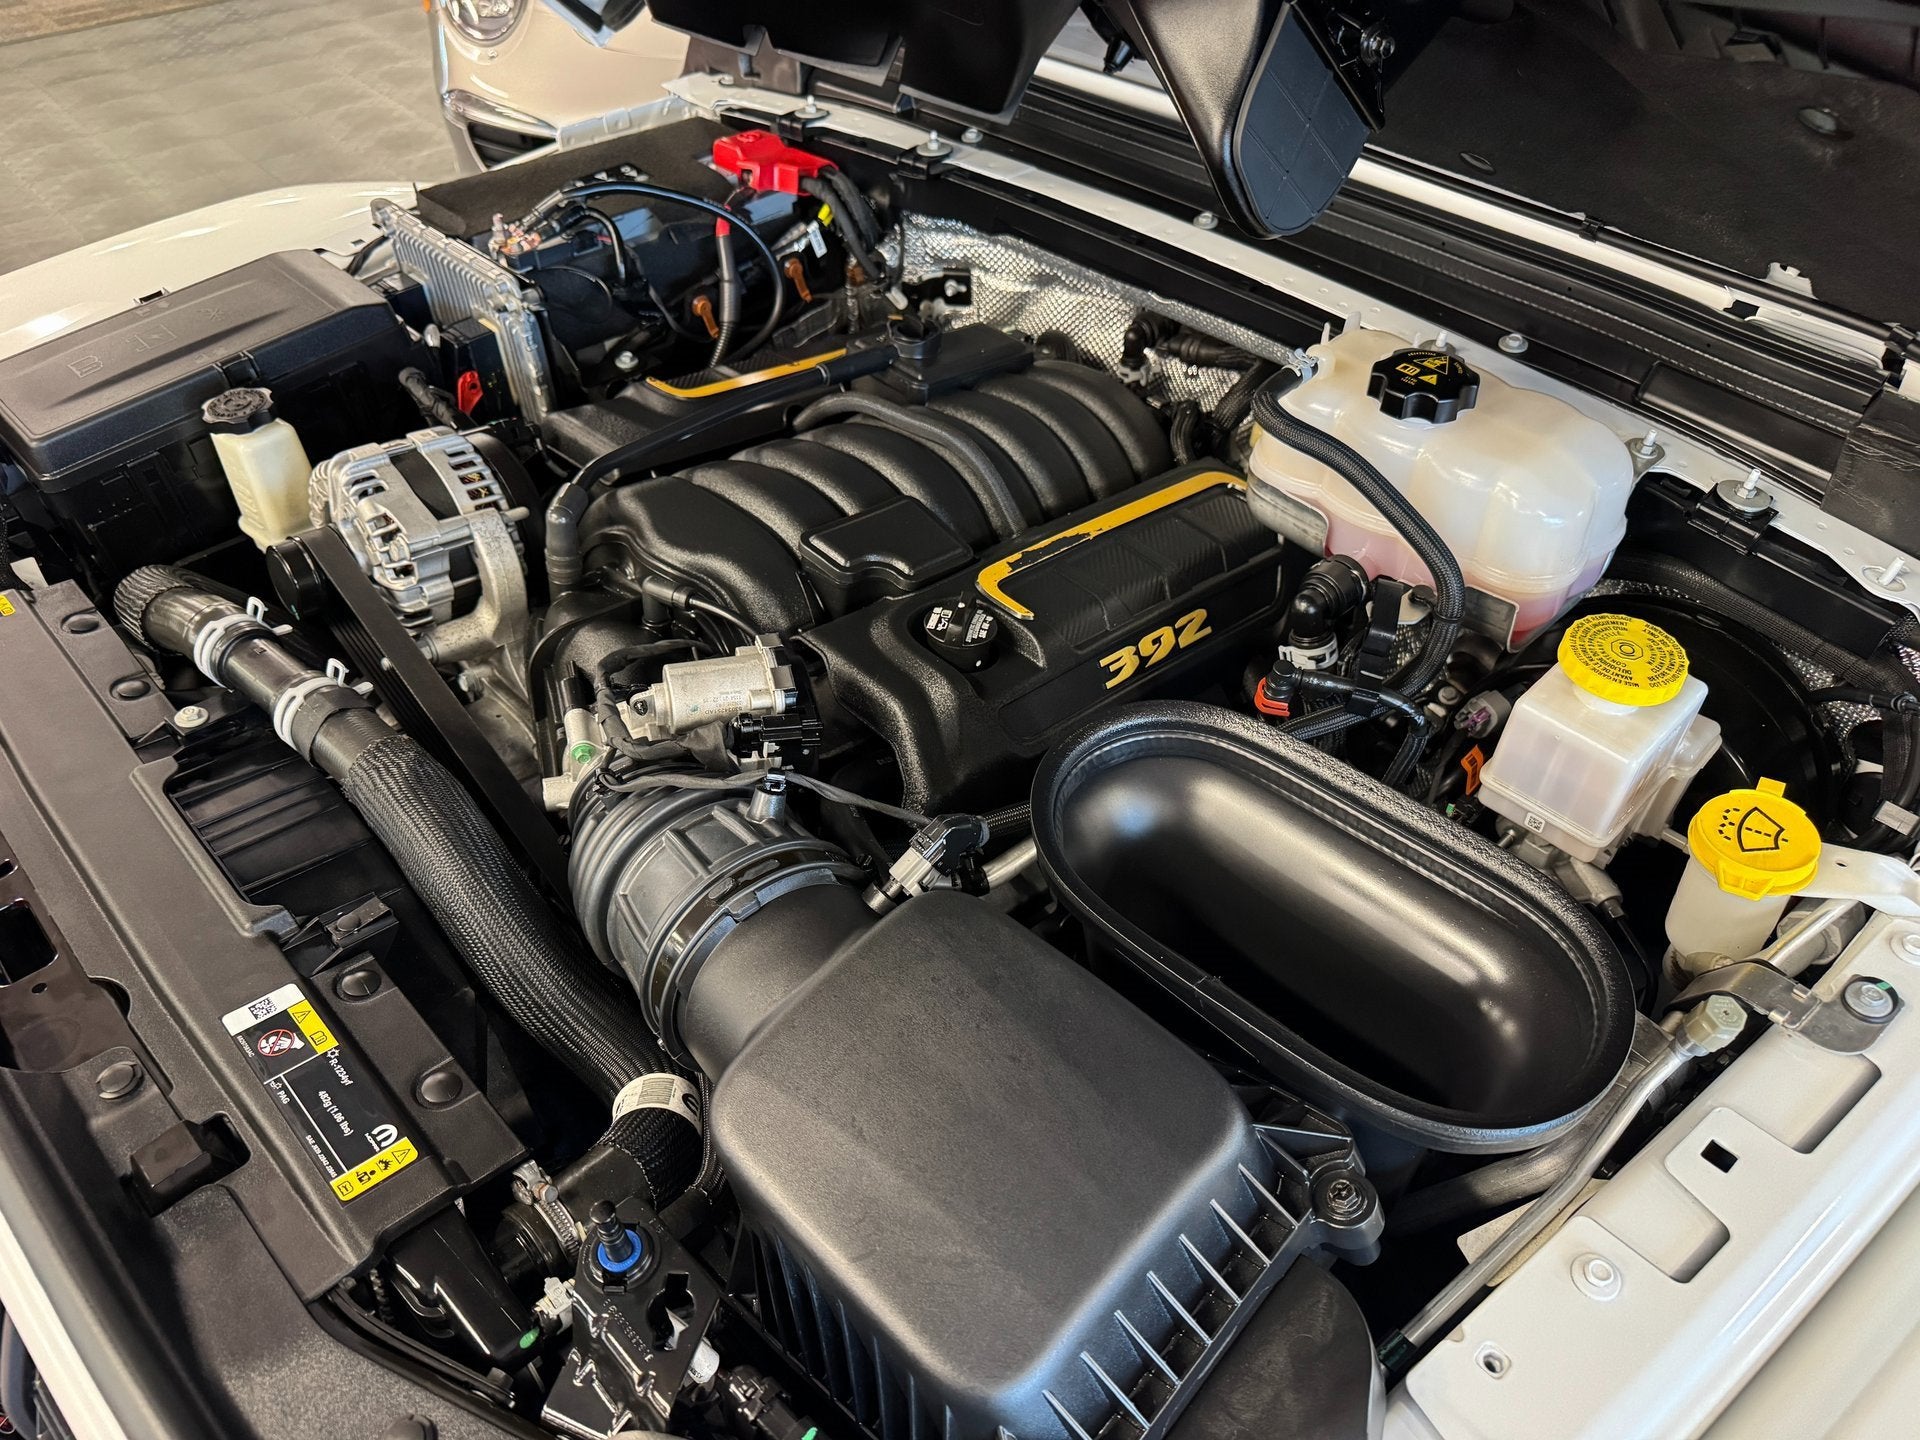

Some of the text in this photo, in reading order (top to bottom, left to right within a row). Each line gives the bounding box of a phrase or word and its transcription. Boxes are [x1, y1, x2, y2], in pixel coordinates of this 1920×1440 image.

[1100, 608, 1212, 690] 392
[329, 1057, 353, 1086] R-1234yf
[277, 1090, 290, 1104] PAG
[318, 1090, 354, 1136] 482g (1.06 lbs)
[305, 1134, 315, 1145] SAE
